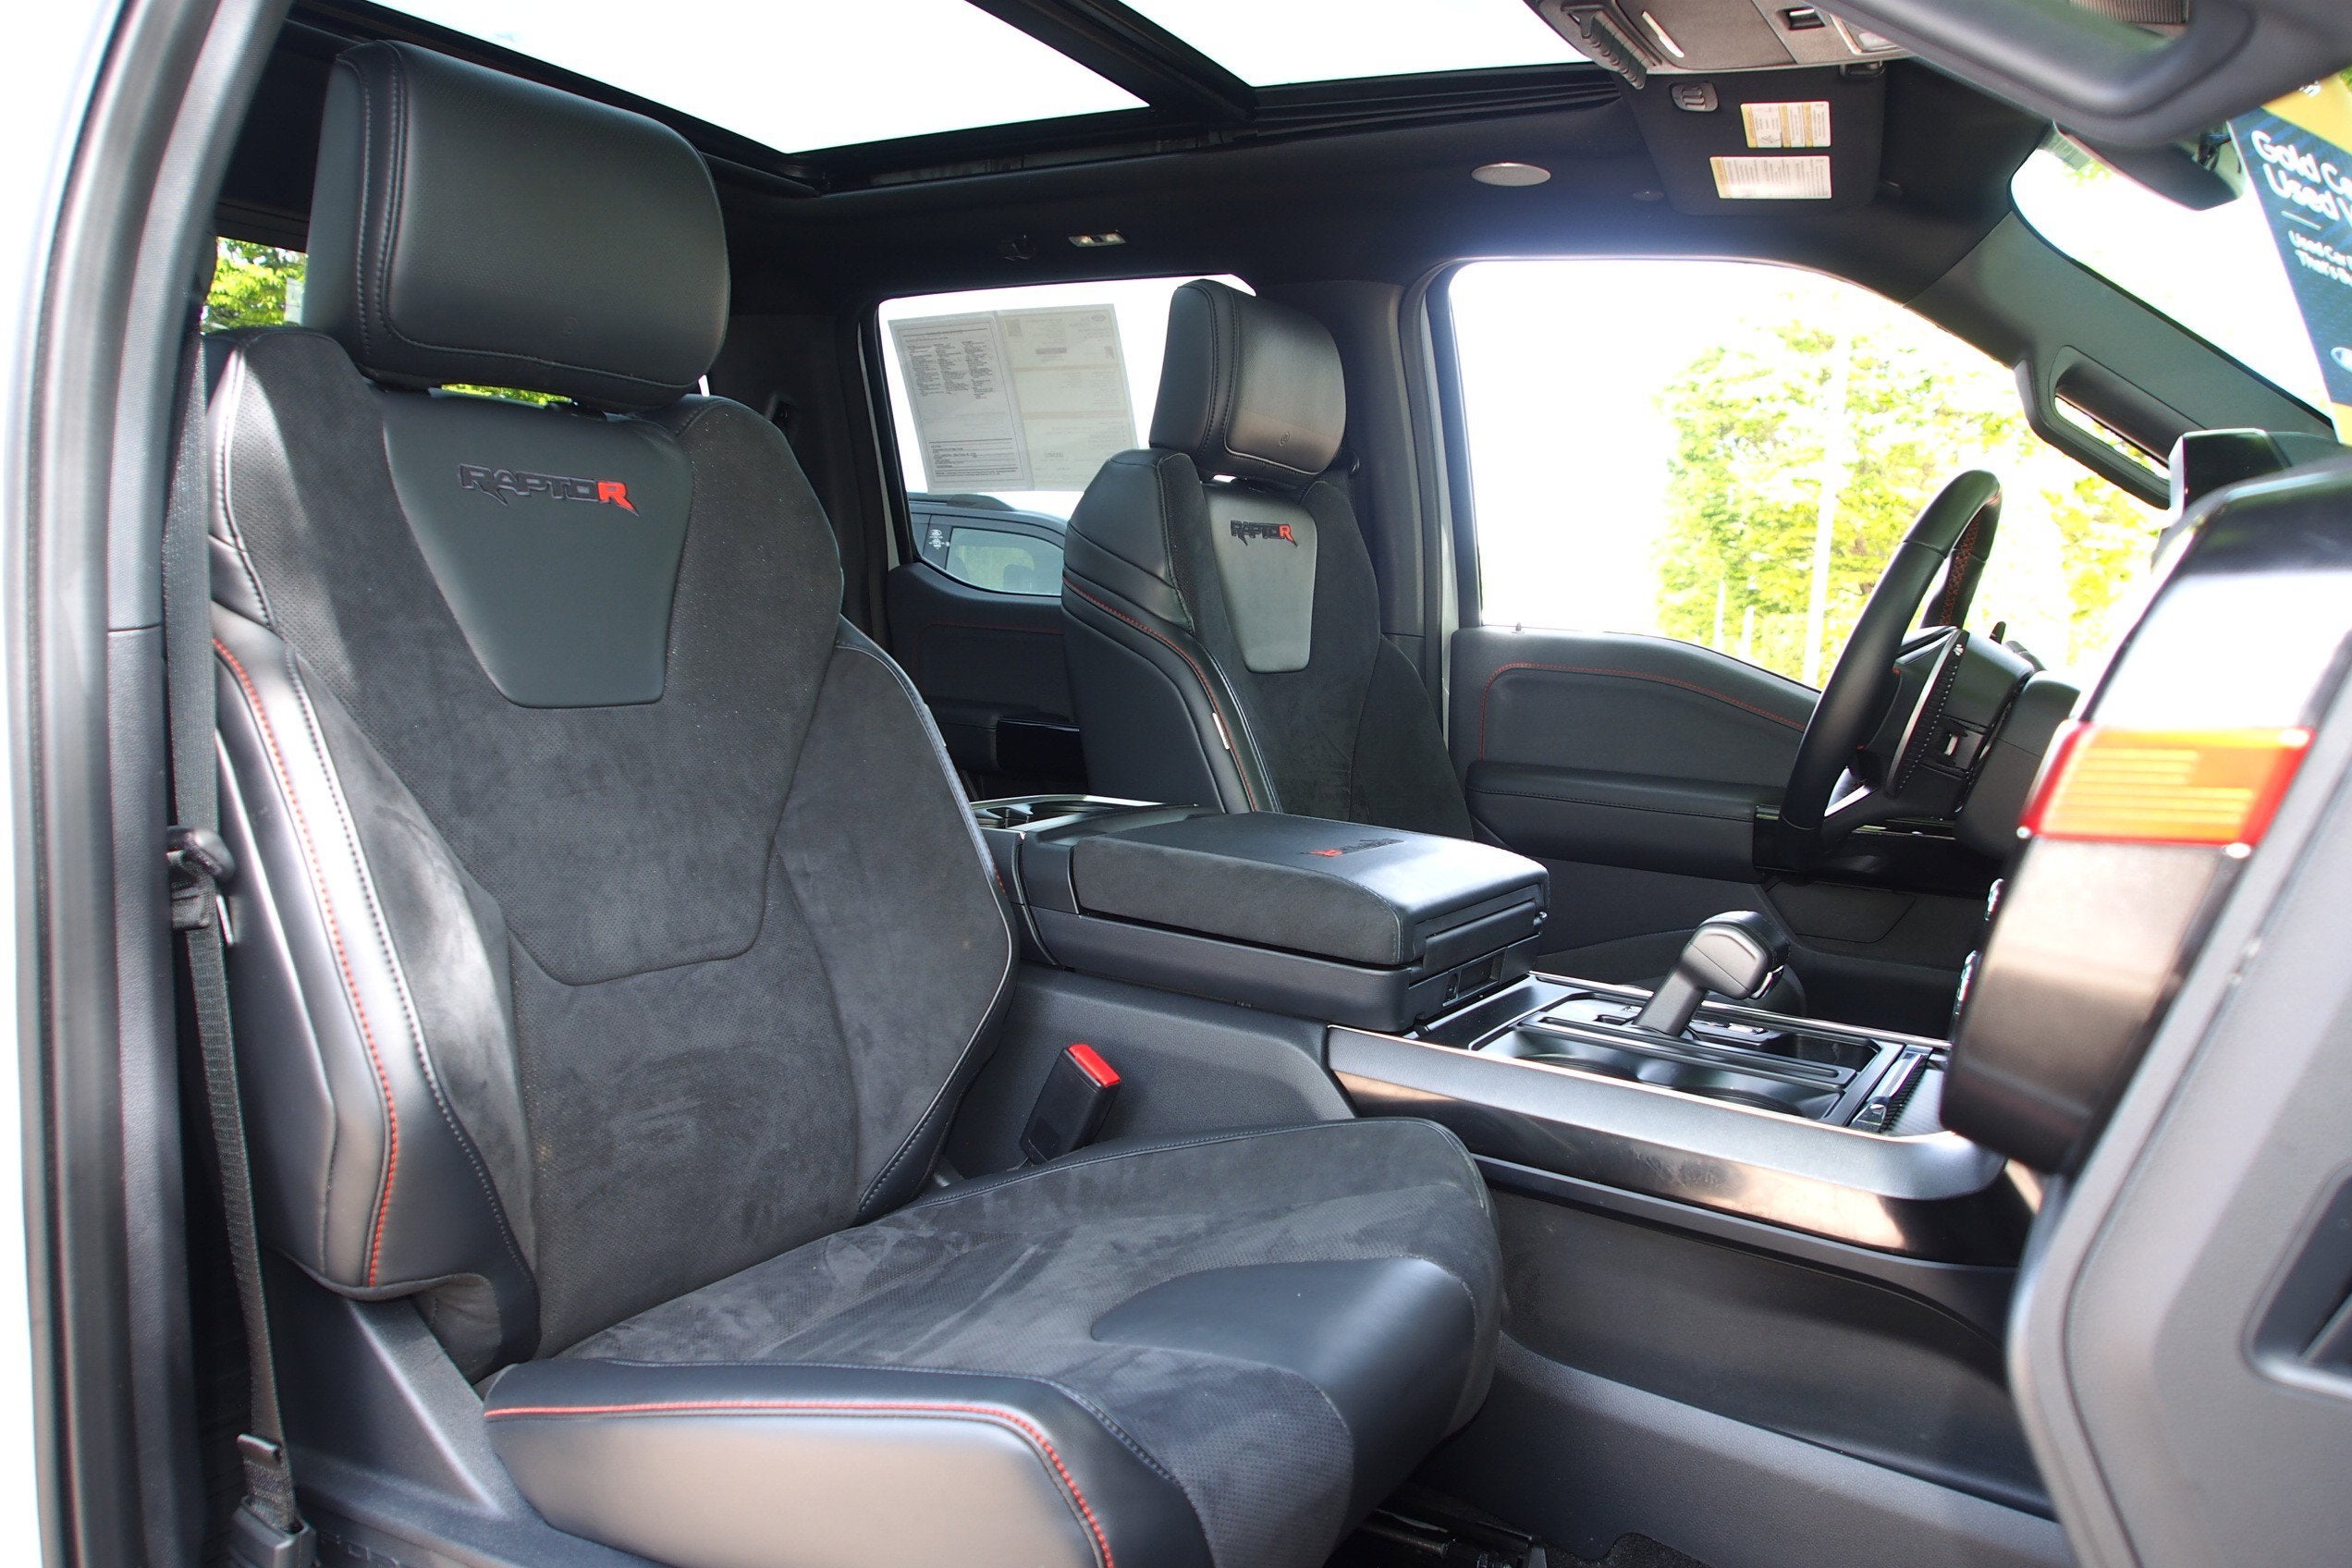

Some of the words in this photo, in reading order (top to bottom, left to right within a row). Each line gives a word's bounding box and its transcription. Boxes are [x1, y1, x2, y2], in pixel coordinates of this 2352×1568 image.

[2250, 129, 2321, 183] Gold
[2262, 163, 2340, 221] Used
[459, 463, 639, 517] RAPTOR
[1230, 520, 1298, 547] RAPTOR
